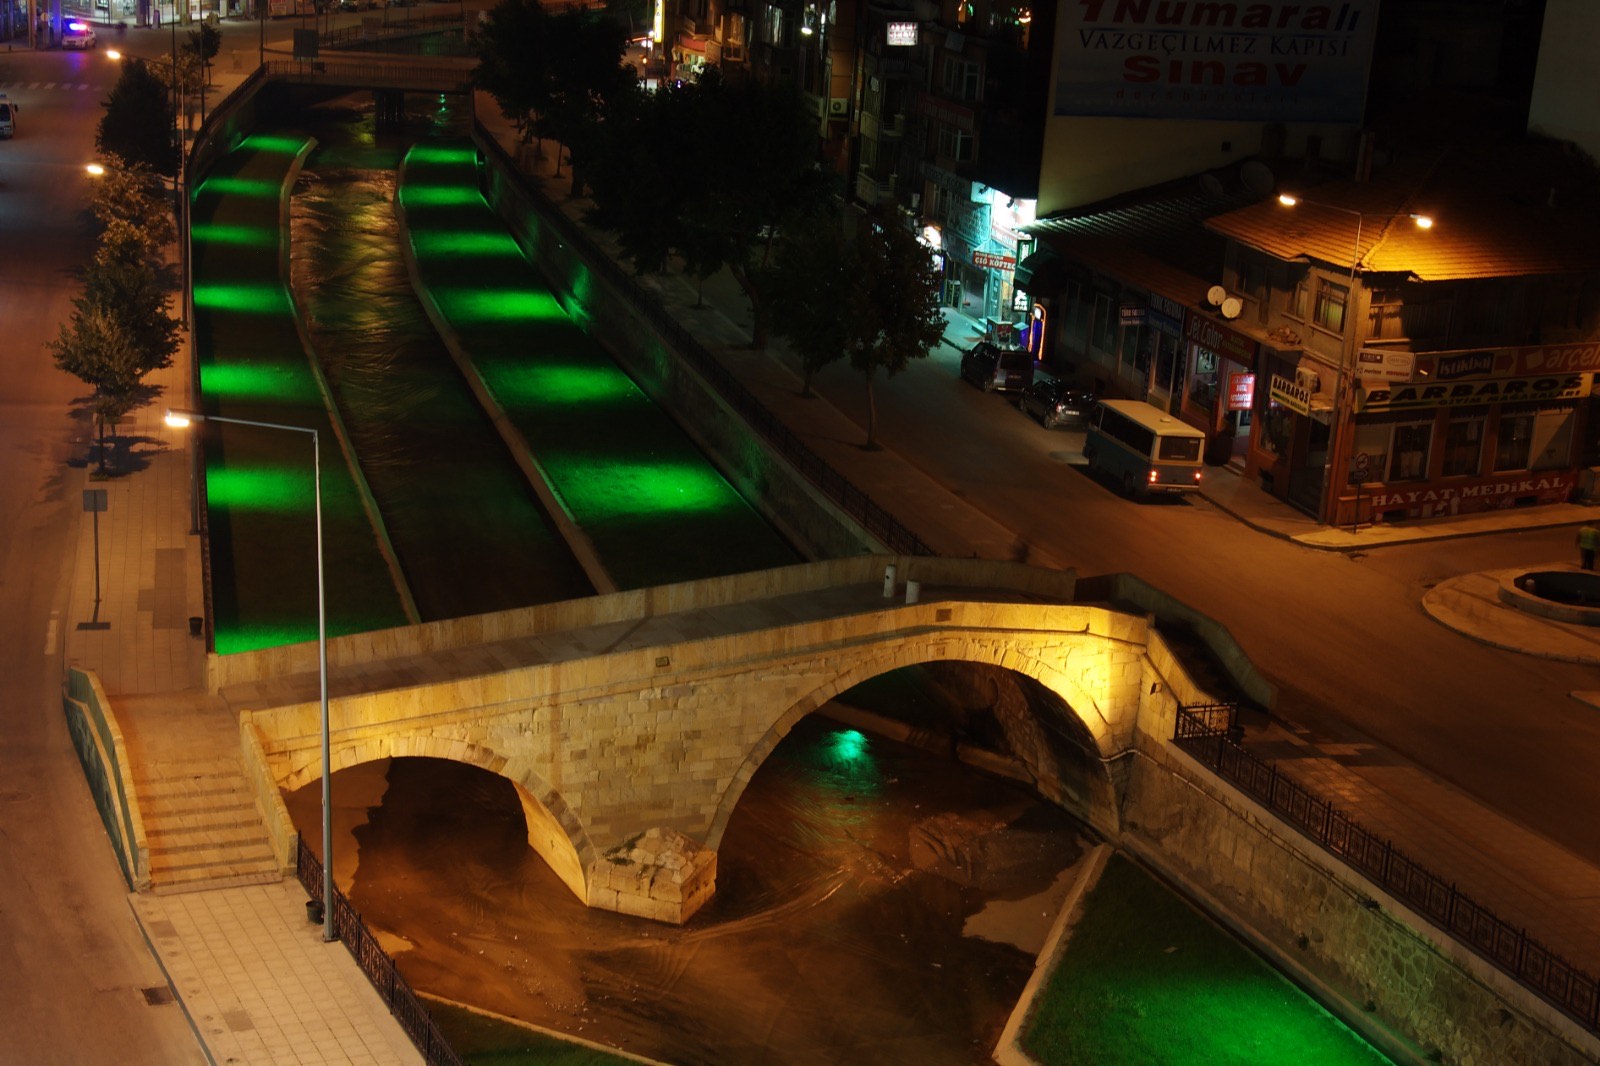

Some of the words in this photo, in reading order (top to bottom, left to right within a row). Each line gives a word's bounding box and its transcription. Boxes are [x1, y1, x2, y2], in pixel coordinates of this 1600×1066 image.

[1123, 55, 1307, 87] Sınav
[1273, 377, 1308, 404] BARBAROS
[1365, 374, 1583, 403] BARBAROS
[1372, 488, 1455, 506] HAYAT
